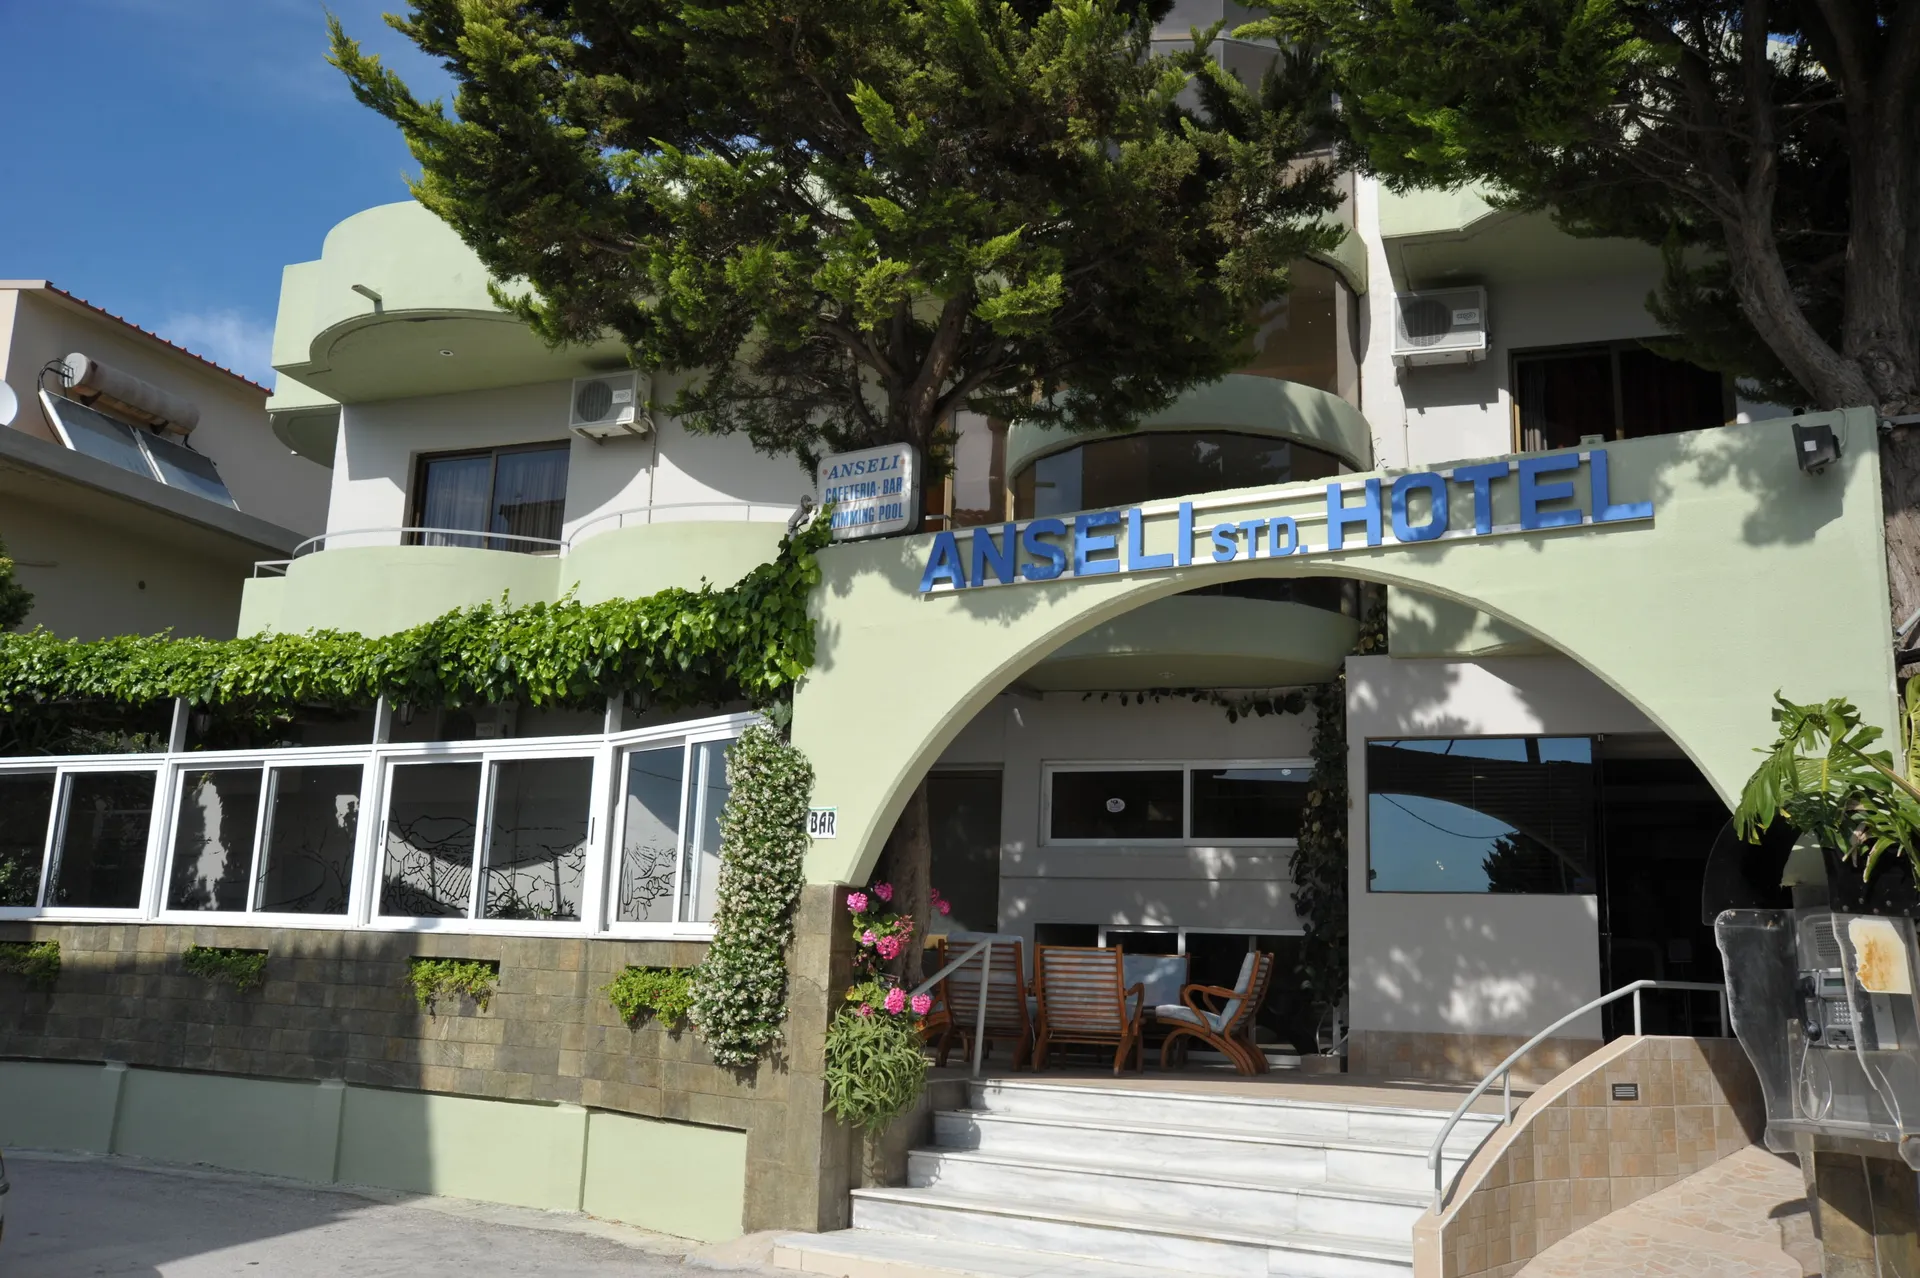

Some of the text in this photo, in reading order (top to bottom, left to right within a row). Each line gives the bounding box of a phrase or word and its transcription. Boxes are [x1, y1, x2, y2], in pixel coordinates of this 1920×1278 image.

[827, 454, 900, 480] ANSELI
[825, 476, 903, 504] CAFETERIA BAR
[830, 502, 904, 529] WIMMING POOL
[919, 449, 1655, 593] ANSELI STD. HOTEL
[810, 811, 836, 836] BAR
